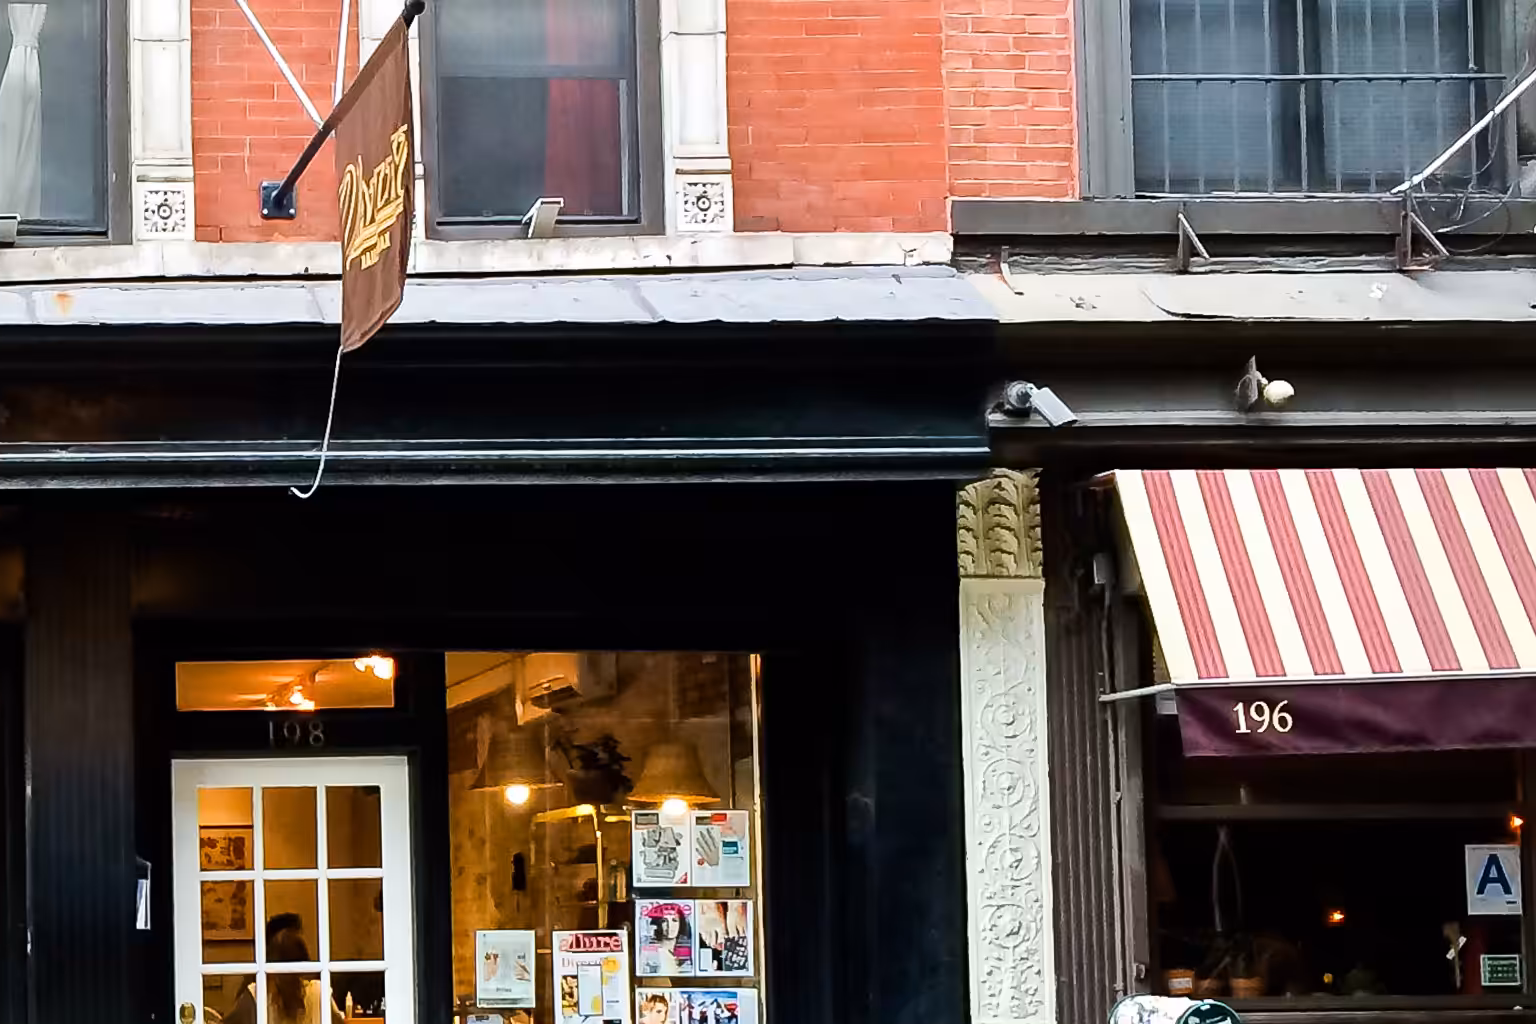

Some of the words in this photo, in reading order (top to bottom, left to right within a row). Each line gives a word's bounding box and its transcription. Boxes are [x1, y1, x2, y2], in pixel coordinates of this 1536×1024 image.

[1232, 699, 1293, 734] 196
[269, 720, 324, 747] 198
[1476, 853, 1513, 896] A
[560, 933, 622, 952] allure
